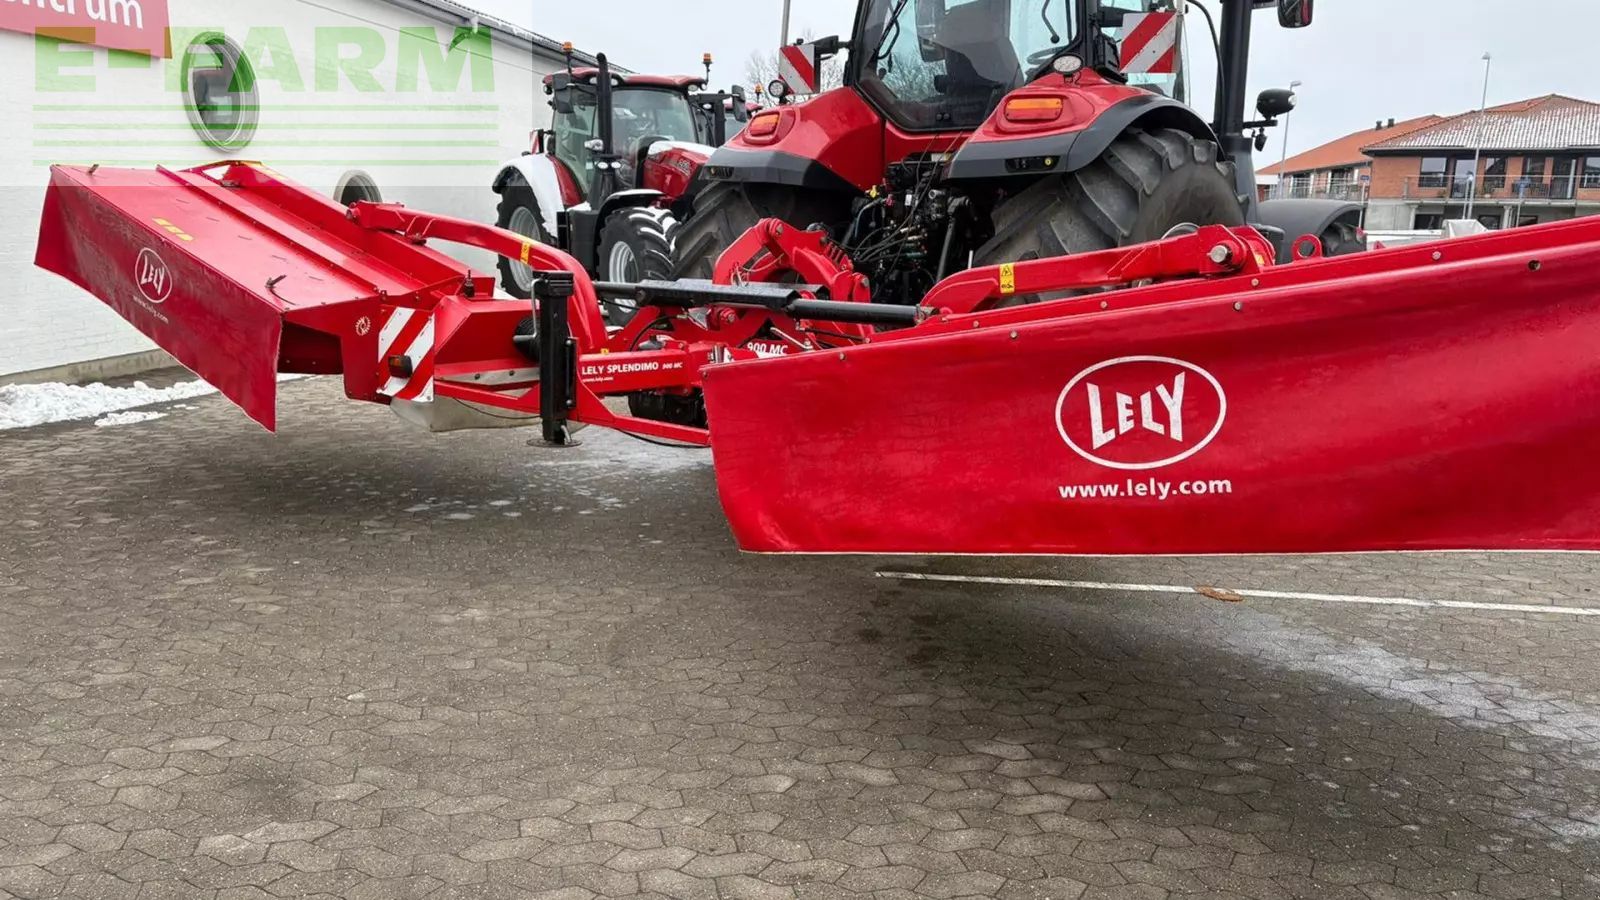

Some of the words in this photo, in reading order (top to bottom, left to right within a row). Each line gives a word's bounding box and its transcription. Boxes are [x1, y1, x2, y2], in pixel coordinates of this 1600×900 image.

[140, 254, 165, 296] LELY
[747, 342, 767, 353] 900
[769, 344, 788, 356] MC
[581, 365, 604, 375] LELY
[607, 361, 659, 374] SPLENDIMO
[1086, 371, 1185, 450] LELY
[1058, 477, 1232, 500] www.lely.com
